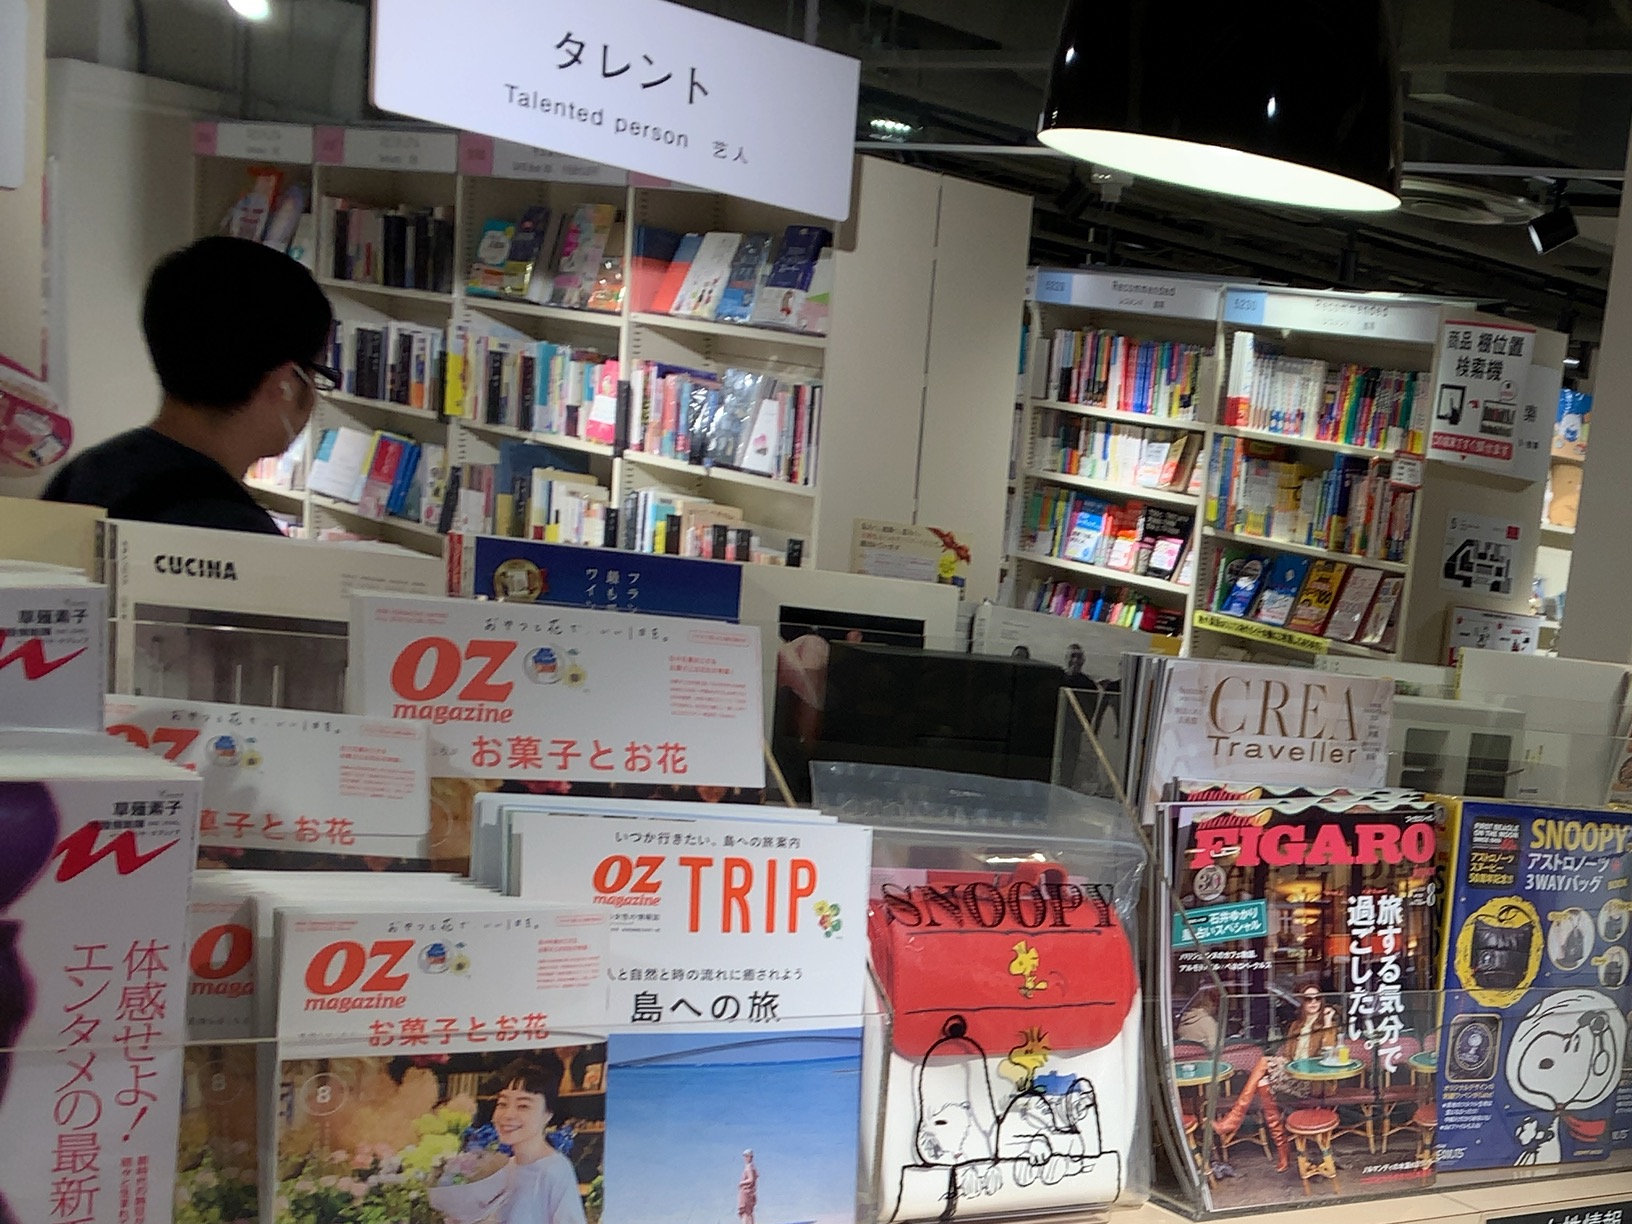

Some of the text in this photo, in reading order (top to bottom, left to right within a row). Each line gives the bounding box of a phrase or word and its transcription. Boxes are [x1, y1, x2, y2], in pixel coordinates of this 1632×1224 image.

[555, 32, 708, 104] タレント
[504, 83, 604, 126] Talented
[614, 117, 689, 148] person
[1112, 280, 1176, 296] Recommended
[1447, 330, 1473, 350] 商品
[1455, 355, 1504, 382] 検索機
[154, 554, 238, 581] CUCINA
[389, 636, 518, 703] OZ
[391, 702, 514, 725] magazine
[1209, 674, 1359, 742] CREA
[471, 735, 690, 775] お菓子とお花
[1209, 733, 1358, 766] Traveller
[1190, 822, 1437, 869] FIGARO
[1527, 852, 1611, 873] アストロノーツ
[591, 854, 819, 934] OZ TRIP
[1524, 873, 1604, 893] 3WAYバッグ
[591, 894, 662, 908] magazine
[880, 880, 1119, 932] SNOOPY
[304, 939, 416, 996] OZ
[1346, 895, 1377, 1050] 過ごしたい。
[1376, 894, 1405, 1073] 旅する気分で
[304, 995, 407, 1013] magazine
[630, 989, 781, 1024] 島への旅
[368, 1012, 550, 1047] お菓子とお花
[316, 1084, 332, 1104] 8
